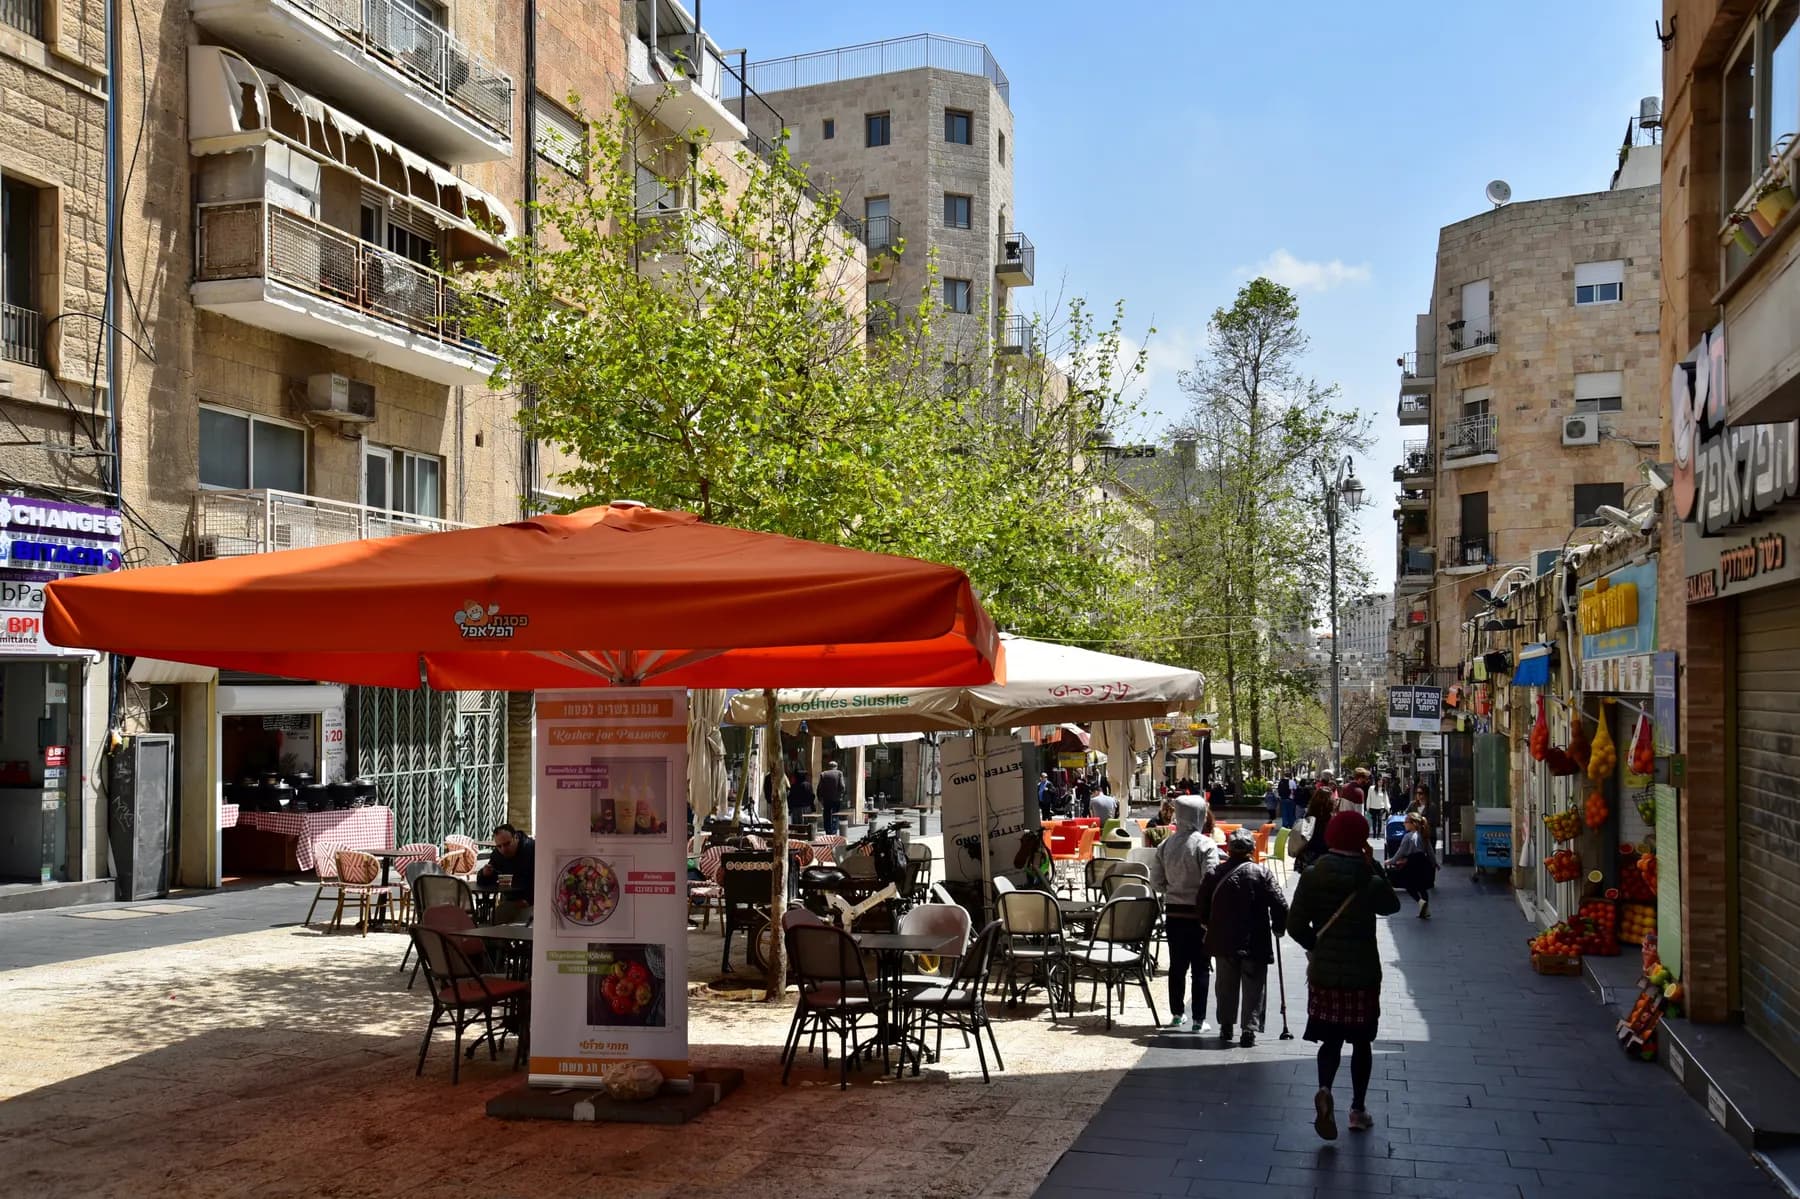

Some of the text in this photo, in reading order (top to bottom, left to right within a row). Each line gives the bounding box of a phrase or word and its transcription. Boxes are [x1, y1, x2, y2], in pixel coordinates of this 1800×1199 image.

[2, 582, 43, 602] bPa
[7, 617, 39, 634] BPI
[493, 616, 528, 626] פסגת
[460, 624, 514, 637] הפלאפל
[778, 694, 909, 713] moothies Slushie
[553, 728, 669, 743] Kosher for Passover
[953, 773, 976, 785] OND
[956, 833, 981, 847] OND
